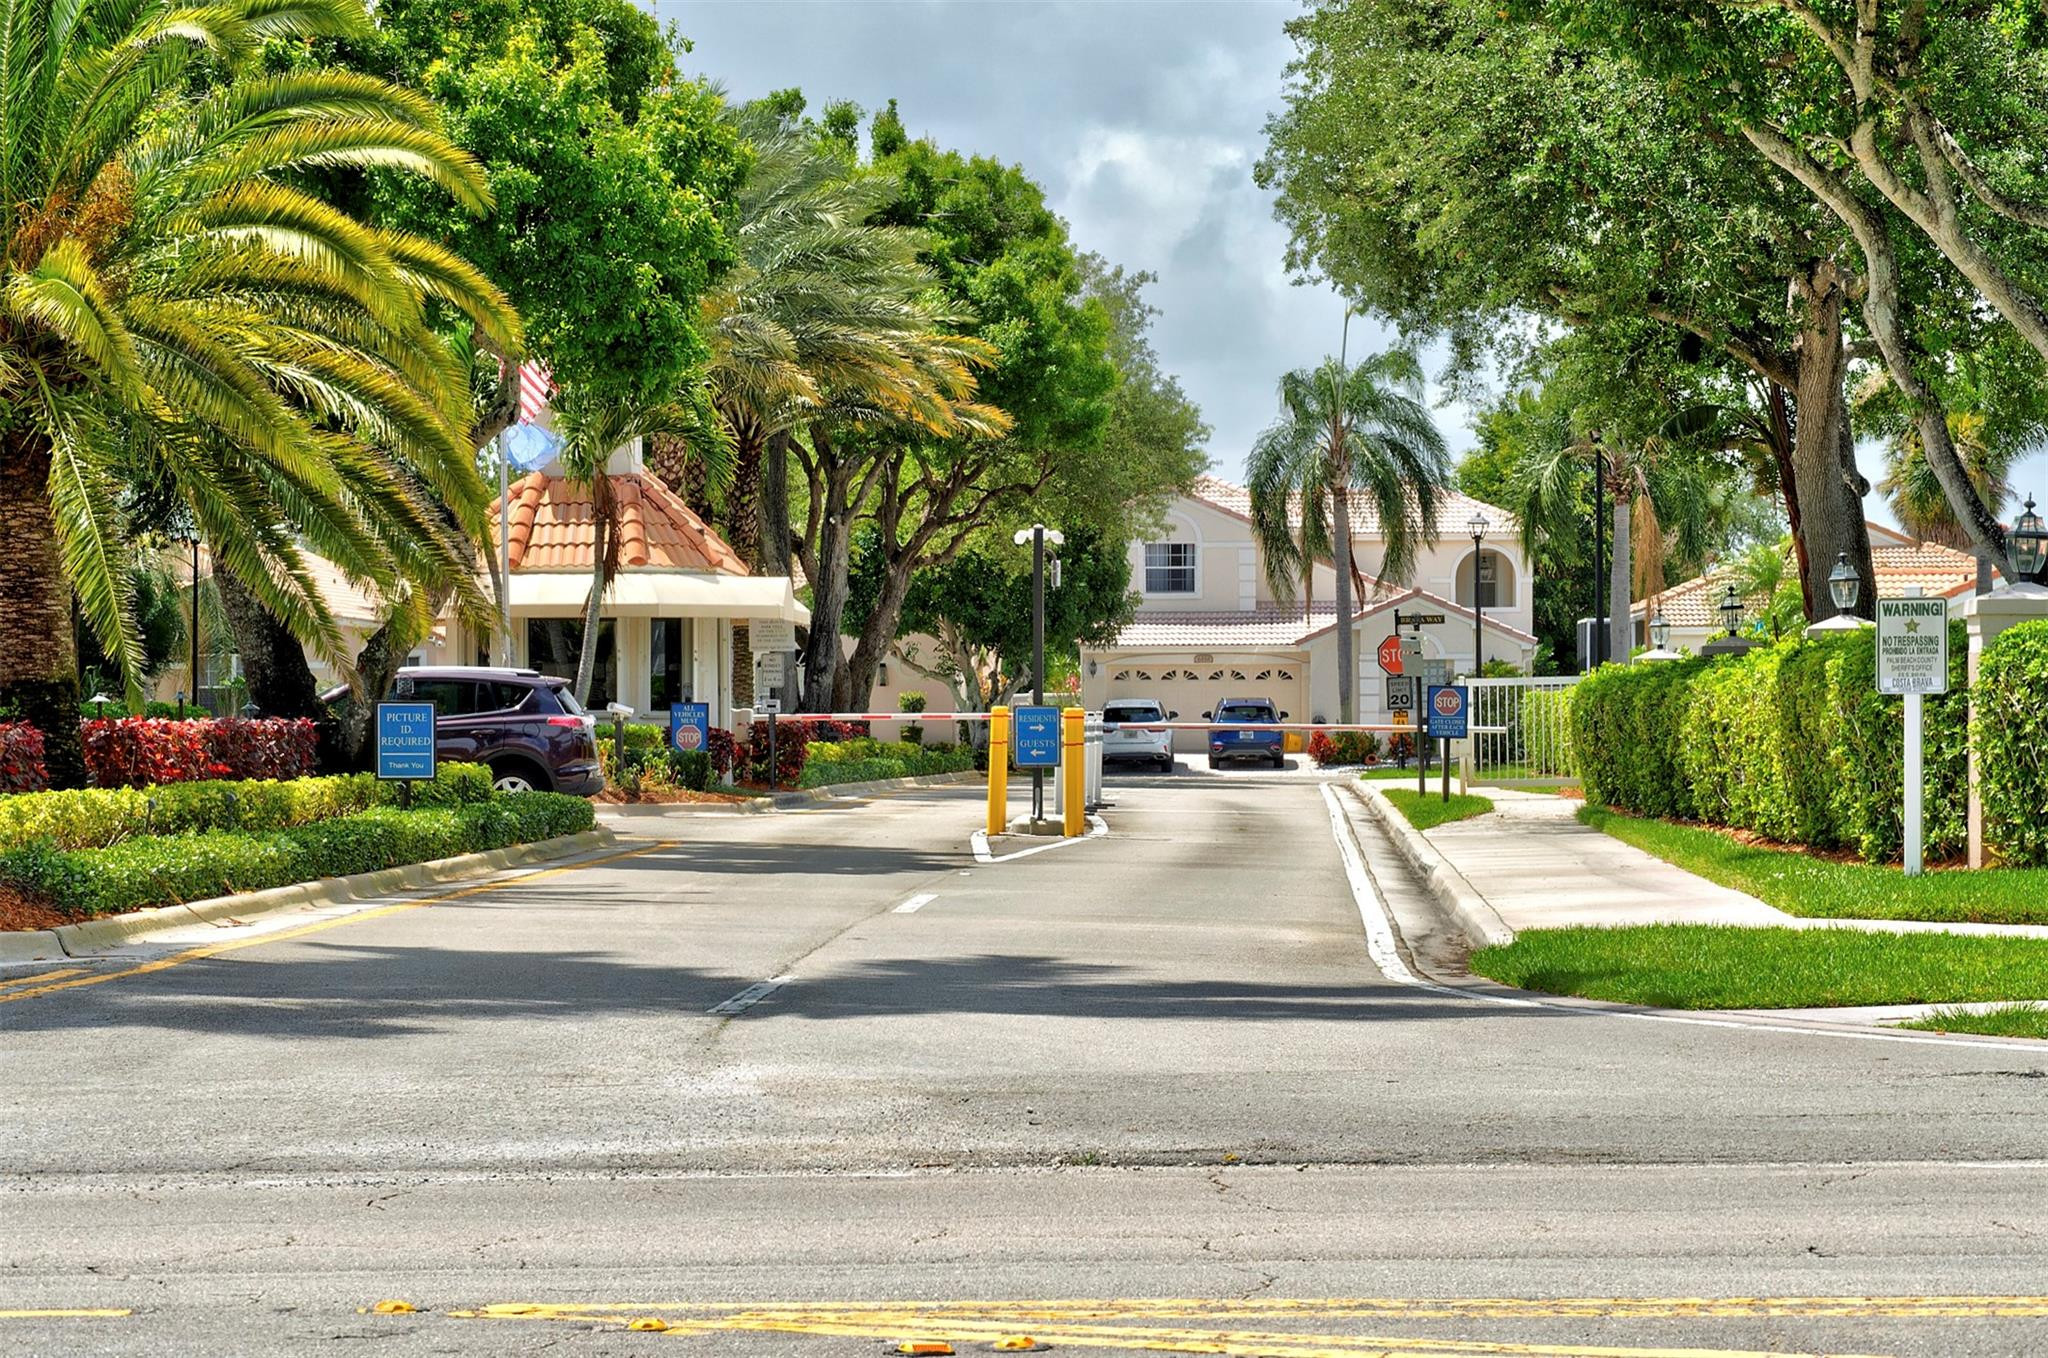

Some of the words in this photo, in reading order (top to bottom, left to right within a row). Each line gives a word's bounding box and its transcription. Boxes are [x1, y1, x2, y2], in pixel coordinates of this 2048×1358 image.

[1882, 603, 1943, 617] WARNING!
[1882, 636, 1893, 647] NO
[1893, 635, 1939, 647] TRESPASSING
[1382, 648, 1402, 663] STO
[1882, 647, 1908, 655] PROHIBIDO
[1909, 647, 1915, 655] LA
[1916, 647, 1939, 655] ENTRADA
[1886, 656, 1900, 664] PALM
[1900, 656, 1917, 664] BEACH
[1917, 656, 1937, 664] COUNTY
[1892, 678, 1911, 688] COSTA
[1912, 677, 1934, 688] BRAVA
[1390, 694, 1409, 705] 20
[1436, 696, 1460, 708] STOP
[386, 713, 428, 722] PICTURE
[1019, 714, 1057, 722] RESIDENTS
[400, 725, 414, 734] ID.
[381, 736, 431, 747] REQUIRED
[678, 732, 700, 743] STOP
[1019, 739, 1056, 748] GUESTS
